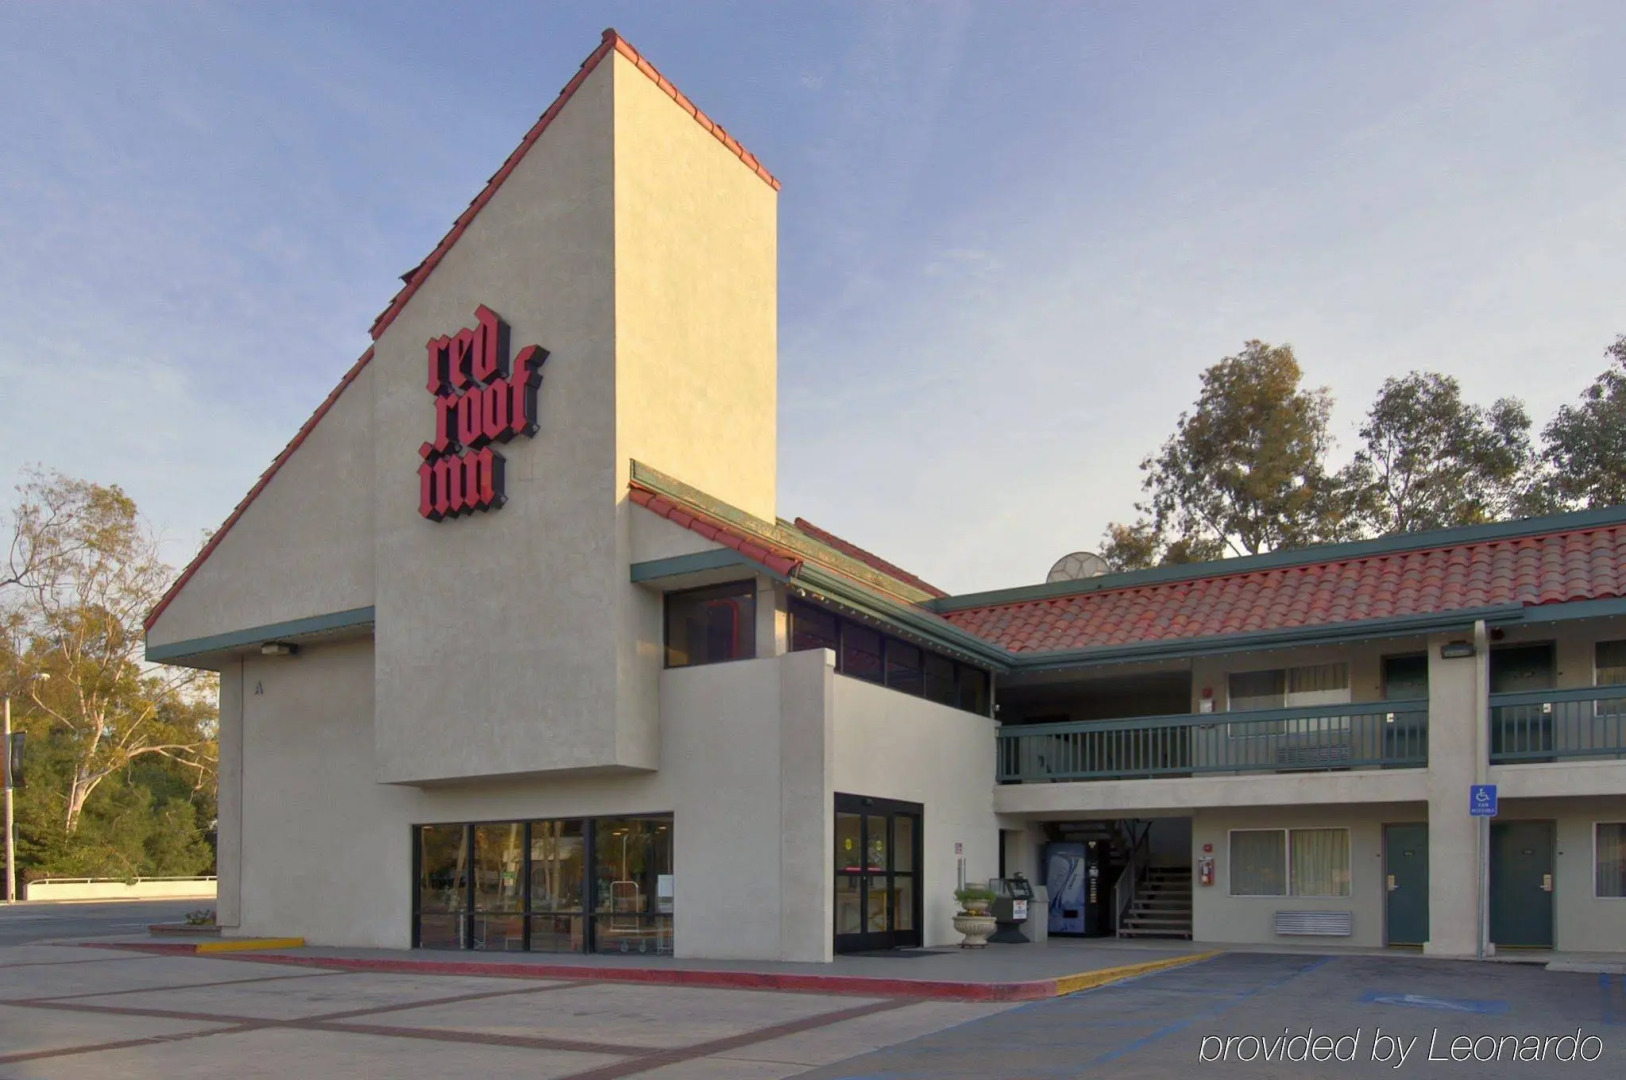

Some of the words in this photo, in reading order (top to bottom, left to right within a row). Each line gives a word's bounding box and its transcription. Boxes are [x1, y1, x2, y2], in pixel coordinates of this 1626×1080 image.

[426, 304, 508, 396] red
[433, 344, 547, 453] roof
[417, 441, 506, 522] inn
